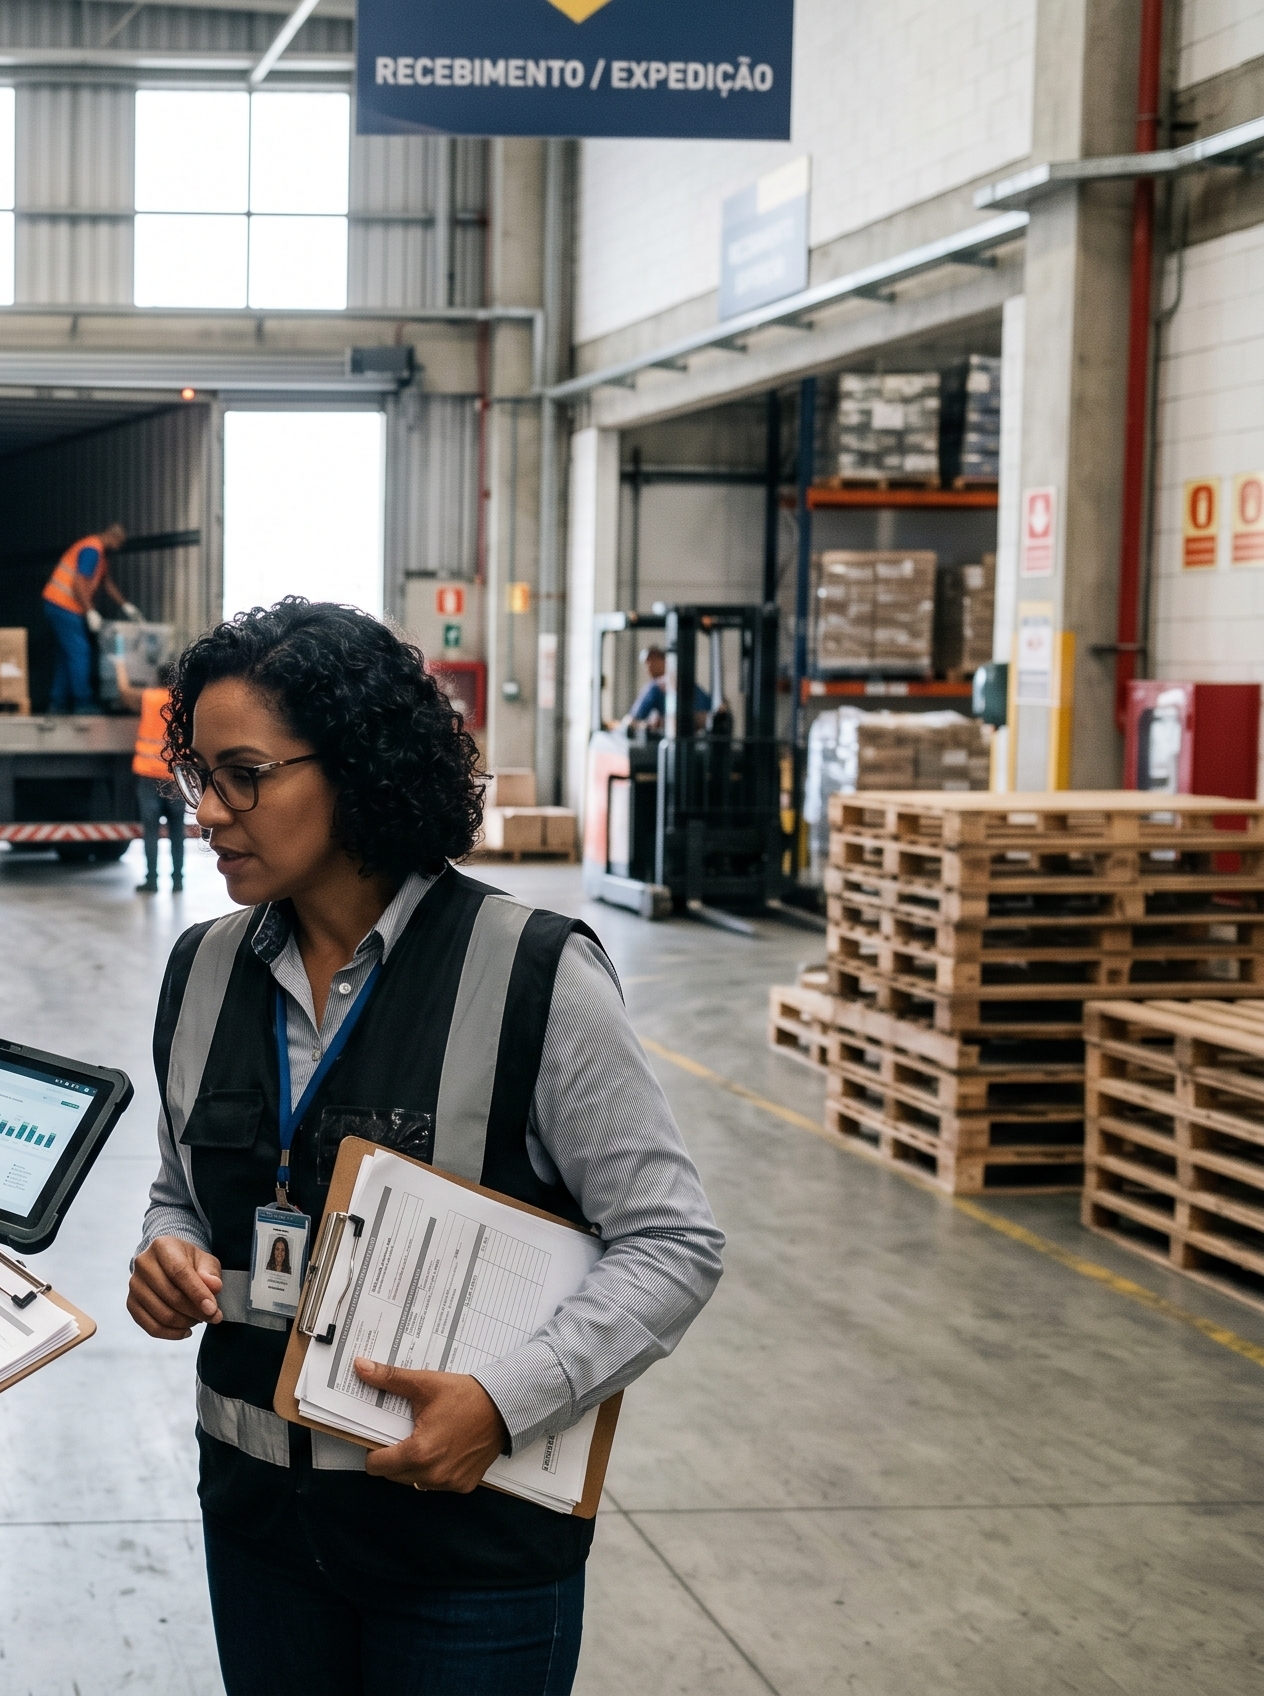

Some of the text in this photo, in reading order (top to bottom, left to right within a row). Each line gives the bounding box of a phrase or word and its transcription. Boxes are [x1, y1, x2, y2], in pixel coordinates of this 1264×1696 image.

[375, 55, 774, 98] RECEBIMENTO / EXPEDIÇÃO
